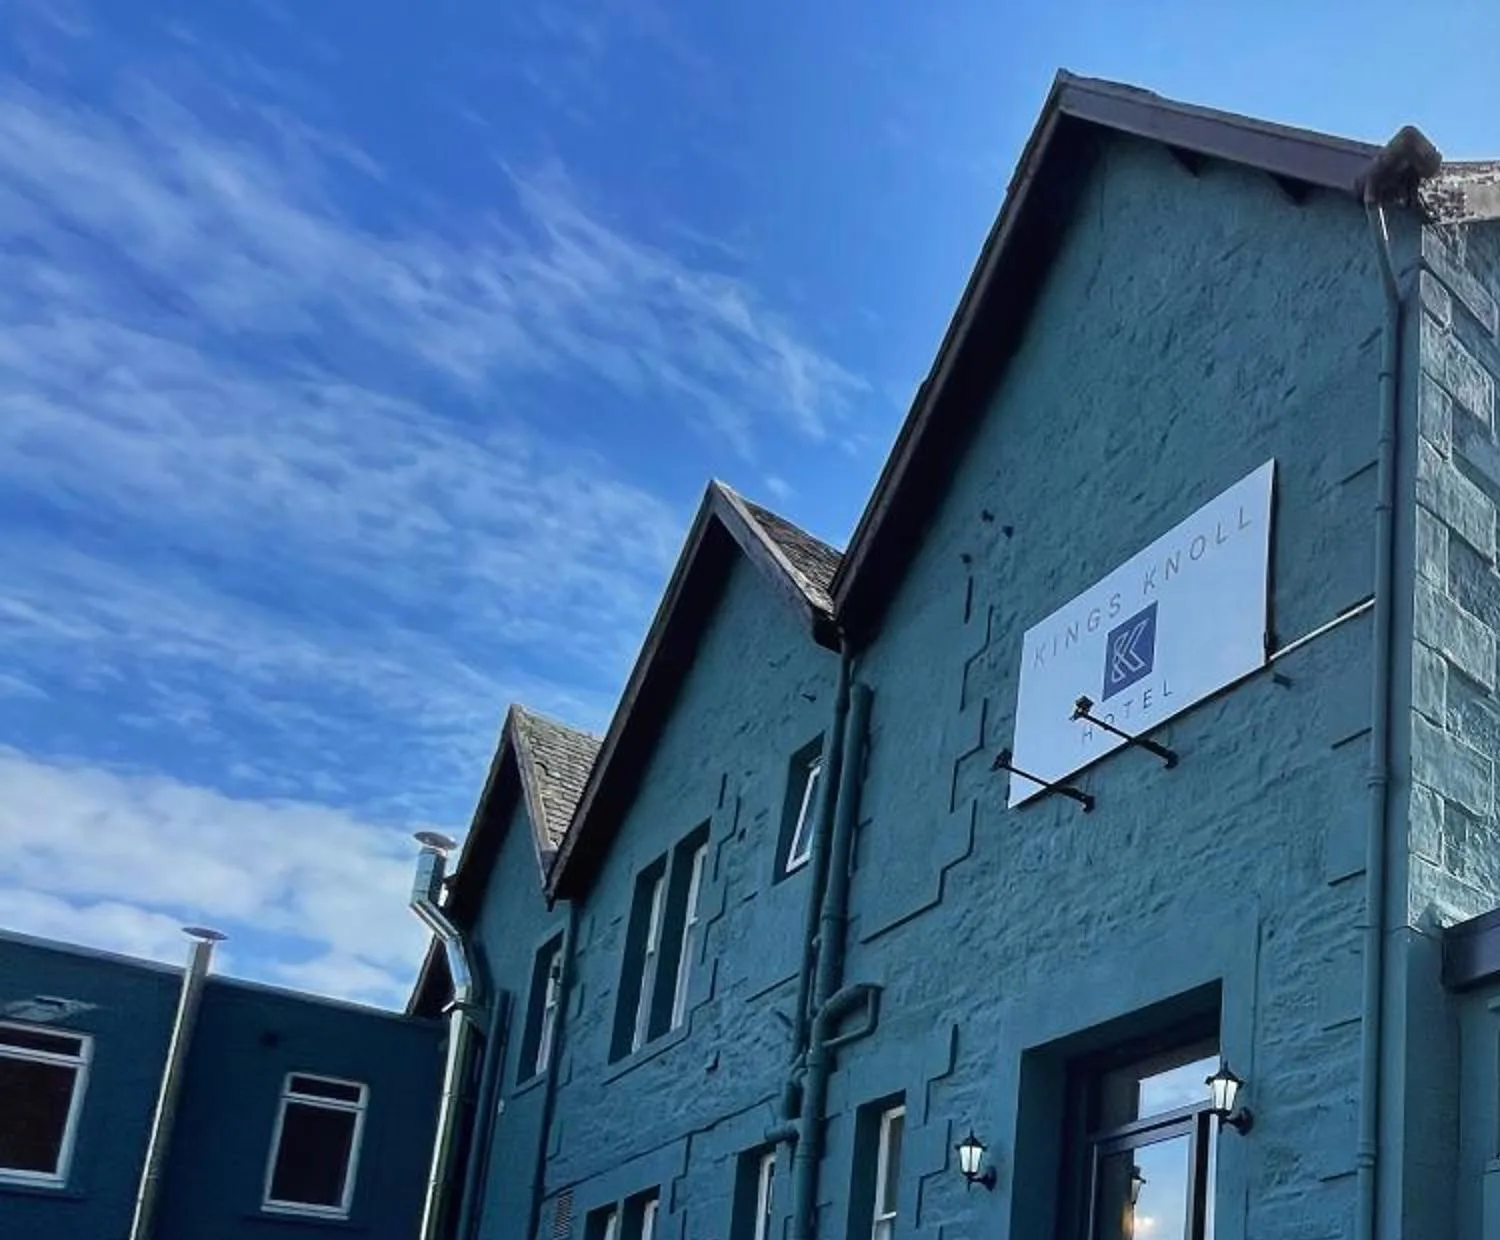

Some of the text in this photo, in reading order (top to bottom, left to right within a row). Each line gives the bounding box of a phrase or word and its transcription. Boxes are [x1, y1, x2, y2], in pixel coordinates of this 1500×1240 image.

[1033, 506, 1252, 669] KINGS KNOLL
[1081, 680, 1174, 744] HOTEL
